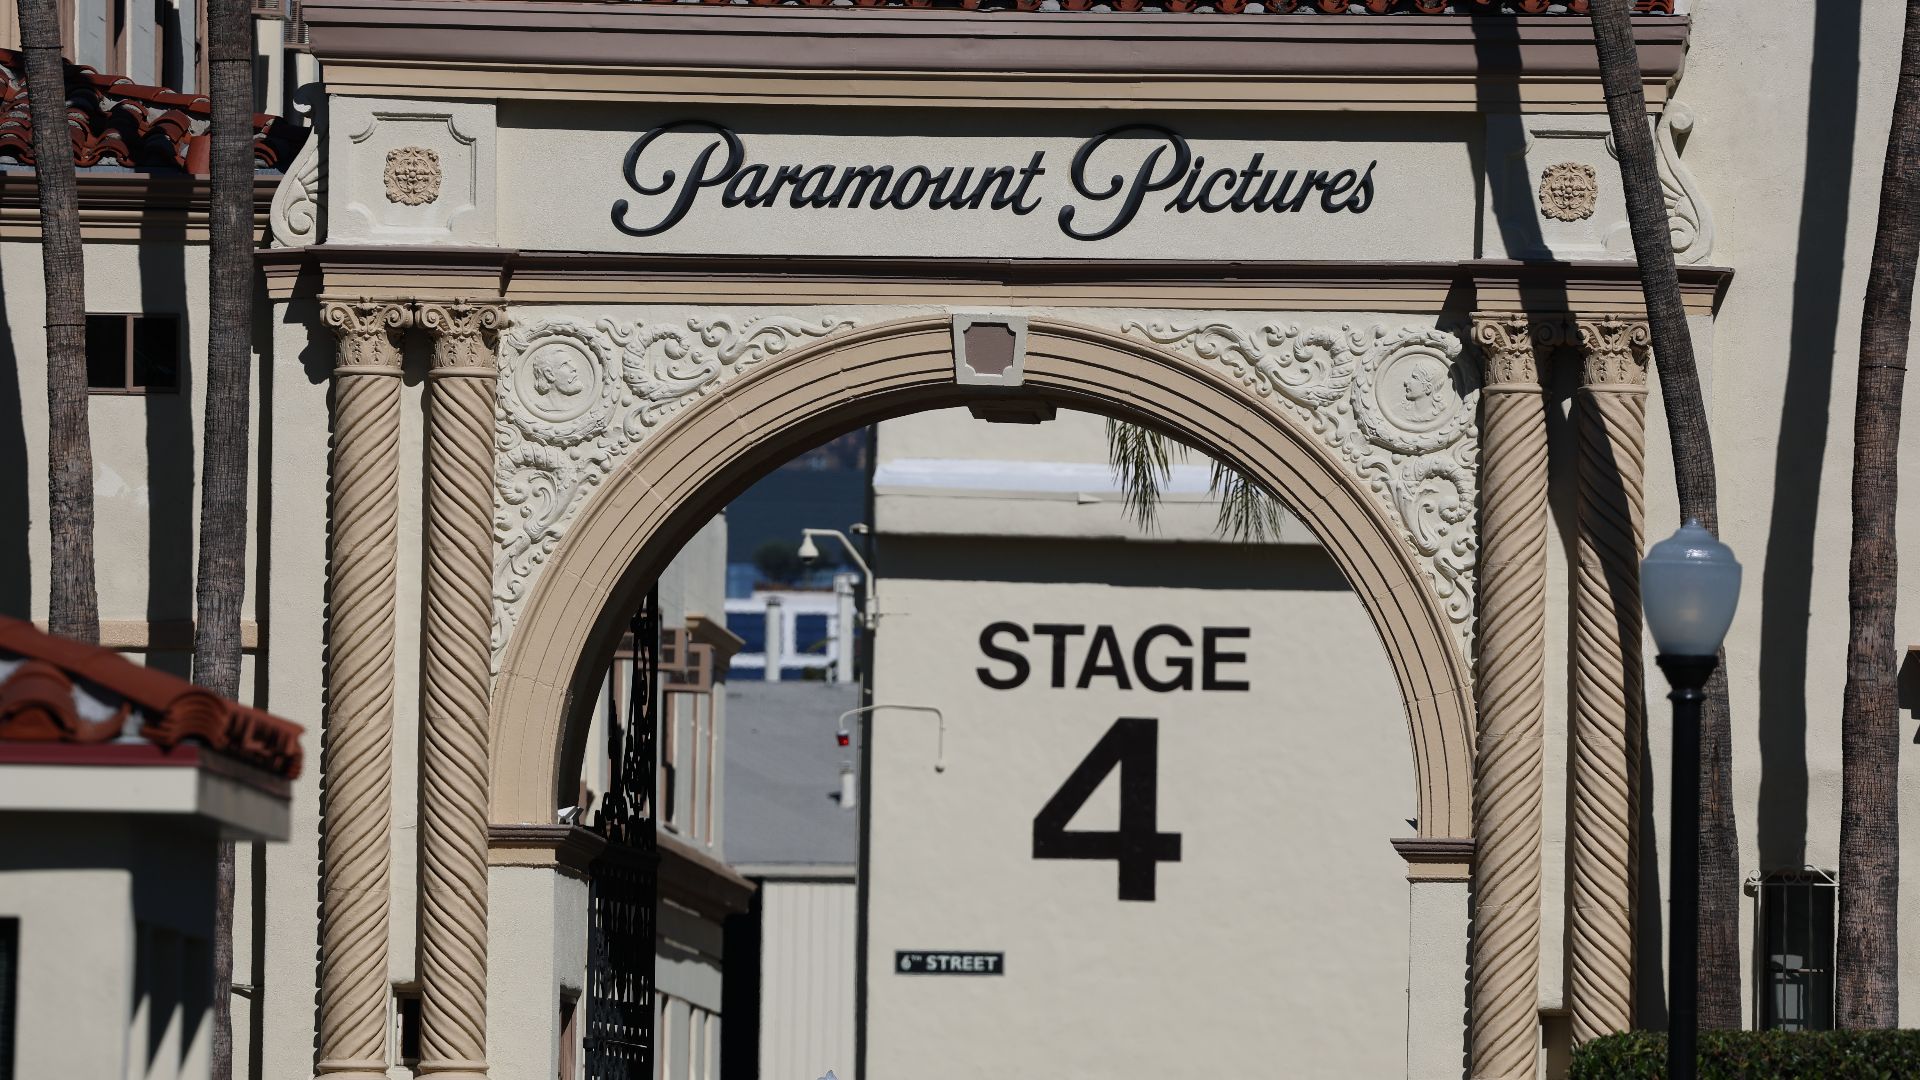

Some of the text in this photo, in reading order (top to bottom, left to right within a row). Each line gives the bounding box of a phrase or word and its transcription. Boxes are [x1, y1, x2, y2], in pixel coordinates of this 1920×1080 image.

[611, 119, 1377, 241] Paramount Pictures
[977, 622, 1250, 692] STAGE
[1033, 717, 1181, 902] 4
[926, 955, 998, 971] STREET
